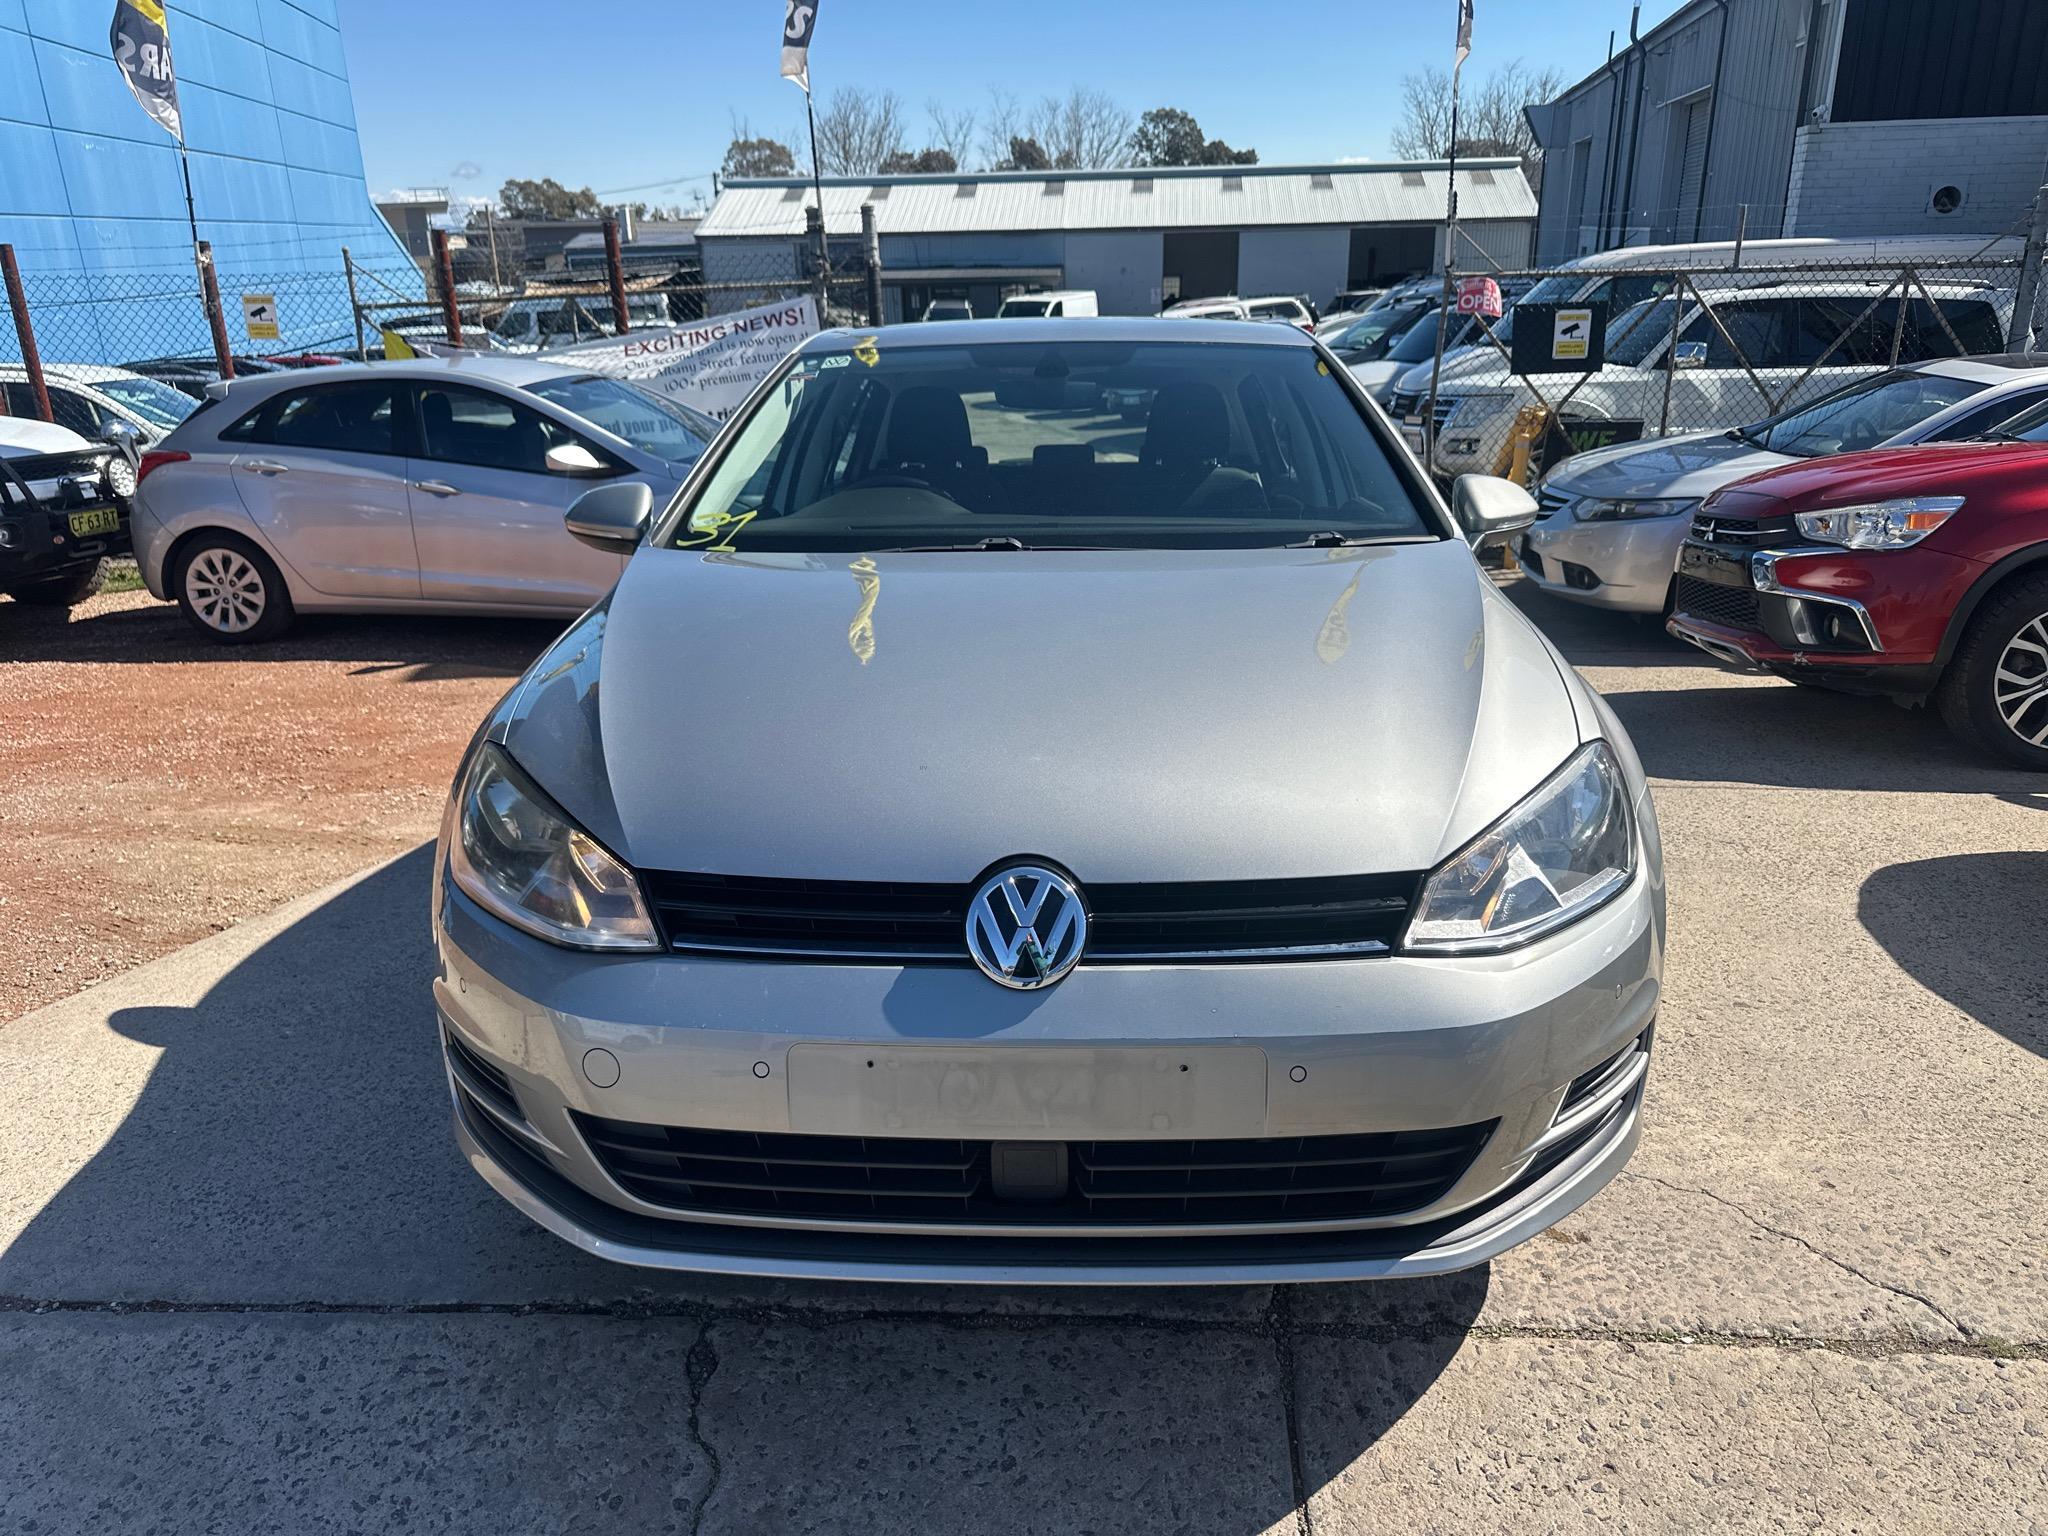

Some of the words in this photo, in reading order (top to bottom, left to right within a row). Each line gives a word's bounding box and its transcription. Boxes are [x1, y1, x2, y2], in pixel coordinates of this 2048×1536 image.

[1460, 294, 1500, 312] OPEN
[624, 325, 727, 357] EXCITING
[733, 308, 805, 334] NEWS!
[653, 350, 694, 366] second
[727, 340, 737, 350] is
[740, 337, 766, 349] now
[768, 333, 797, 349] open
[657, 363, 697, 378] Albany
[700, 356, 738, 371] Street,
[741, 350, 787, 366] featurin
[700, 371, 751, 391] premium
[622, 420, 657, 436] your
